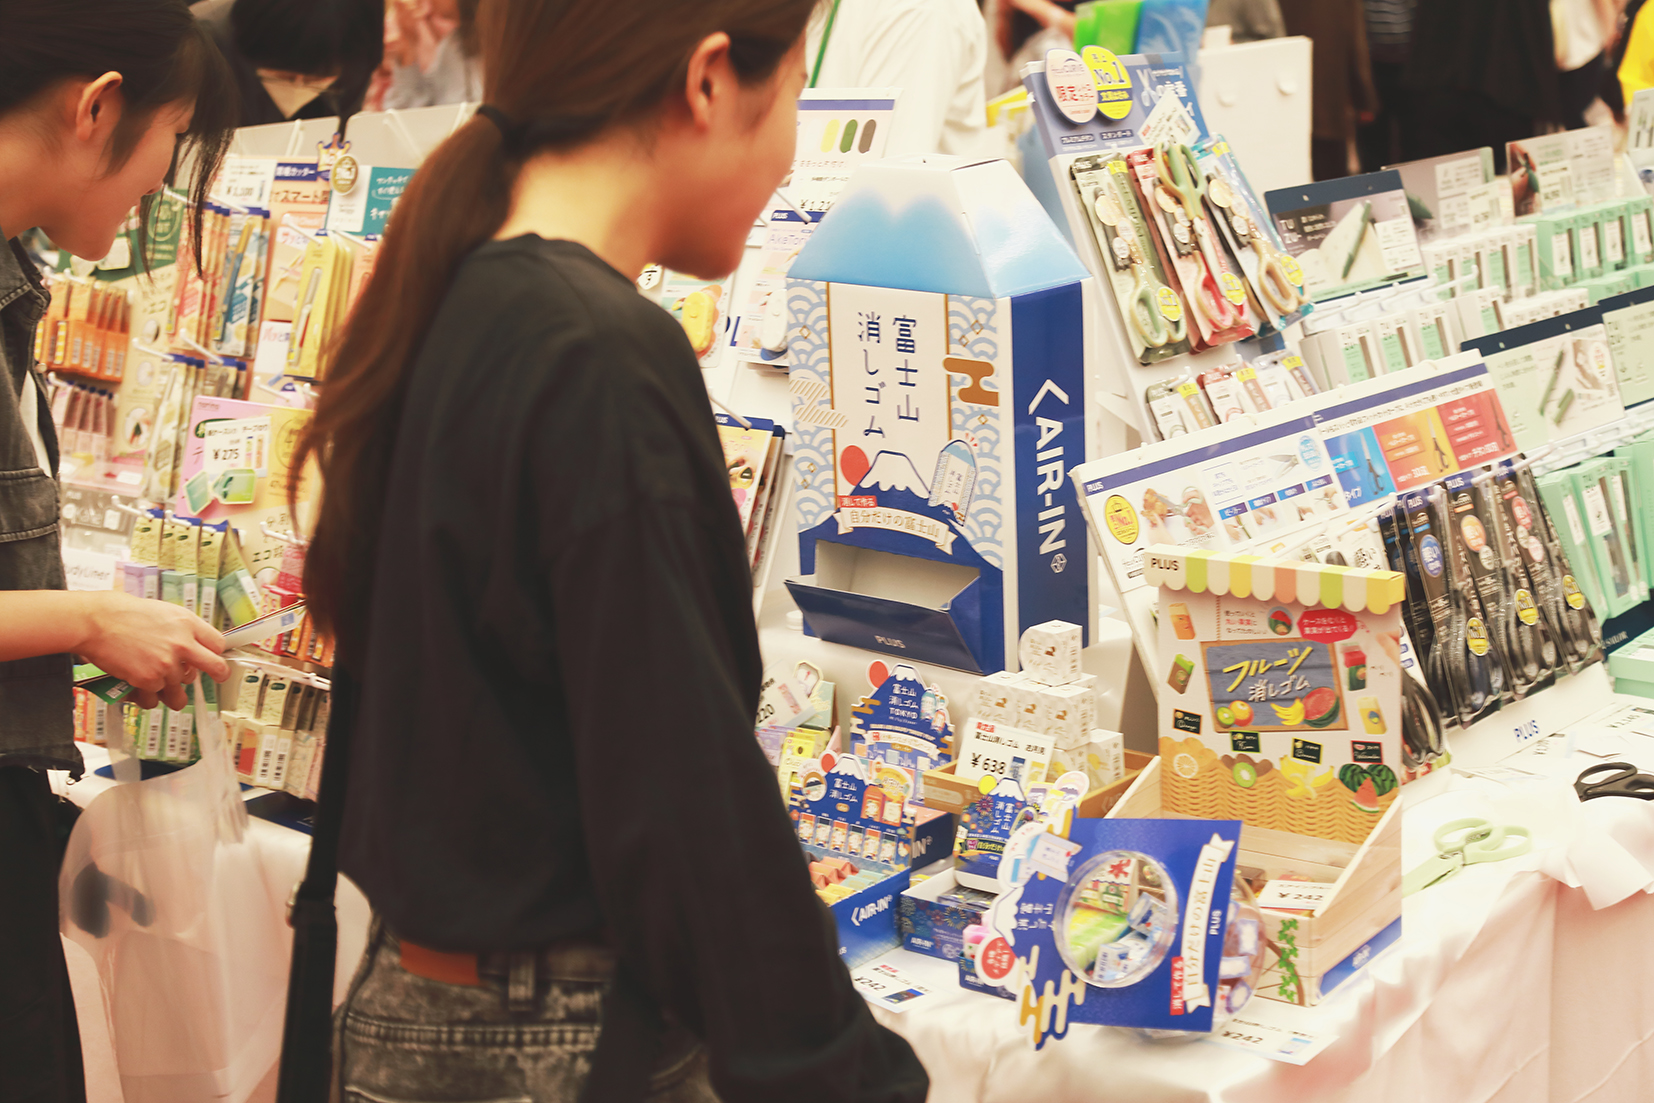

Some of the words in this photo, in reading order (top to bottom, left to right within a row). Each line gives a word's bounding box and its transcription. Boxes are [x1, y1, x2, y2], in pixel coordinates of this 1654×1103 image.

[1093, 61, 1127, 86] No.1
[857, 311, 887, 439] 消しゴム
[892, 314, 921, 423] 富士山
[212, 448, 240, 461] ¥275
[1035, 416, 1067, 556] AIR-IN
[1446, 477, 1465, 489] PLUS
[1408, 496, 1424, 507] PLUS
[849, 509, 941, 539] 自分だけの富士山
[1150, 558, 1180, 571] PLUS
[874, 634, 907, 650] PLUS
[1222, 646, 1313, 693] フルーツ
[892, 683, 917, 697] 富士山
[1248, 673, 1312, 703] 消しゴム
[888, 695, 919, 709] 消しゴム
[889, 707, 918, 719] TOKYO
[975, 731, 1019, 749] 富士山消しゴム
[1513, 719, 1540, 744] PLUS
[970, 752, 1007, 775] ¥638
[833, 777, 858, 792] 富士山
[828, 788, 859, 803] 消しゴム
[1001, 802, 1015, 832] 富士山
[1278, 891, 1324, 902] ¥242
[858, 898, 890, 922] AIR-IN
[1185, 856, 1218, 987] 自分だけの富士山
[1209, 909, 1222, 936] PLUS
[854, 975, 887, 992] ¥242
[1221, 1029, 1264, 1045] ¥242
